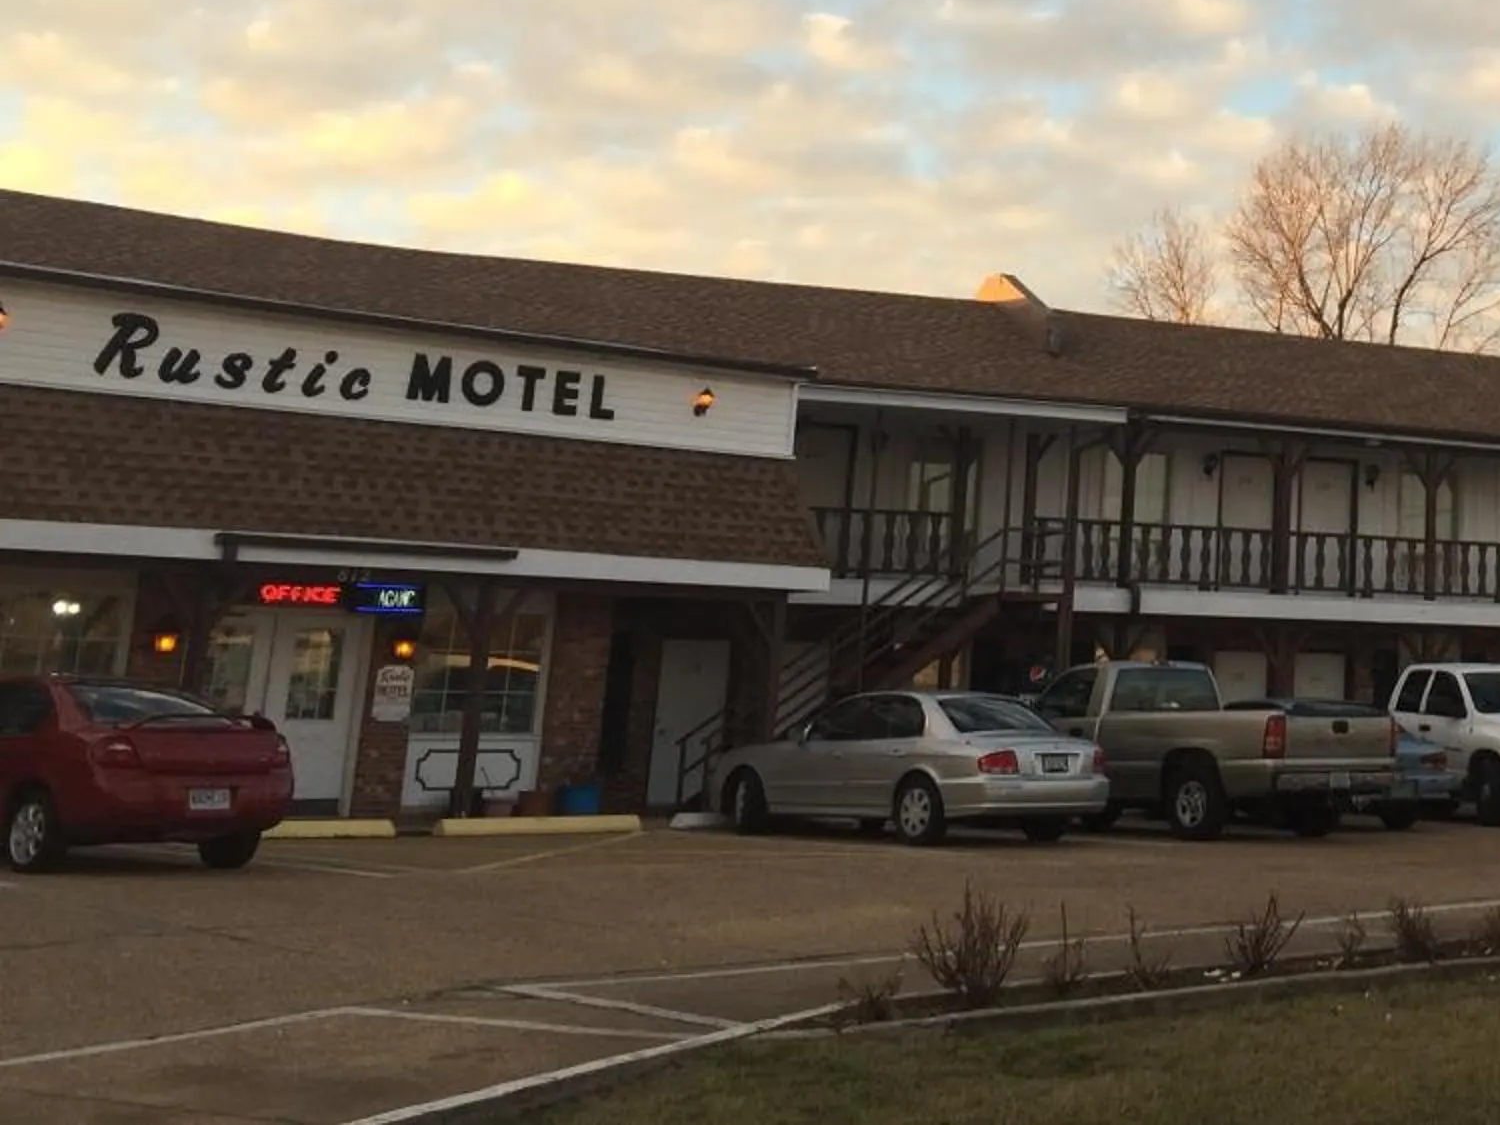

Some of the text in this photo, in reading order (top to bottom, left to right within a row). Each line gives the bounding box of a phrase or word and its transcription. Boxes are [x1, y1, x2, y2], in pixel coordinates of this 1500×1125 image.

[94, 312, 616, 421] Rustic MOTEL
[259, 584, 341, 604] OFFICE
